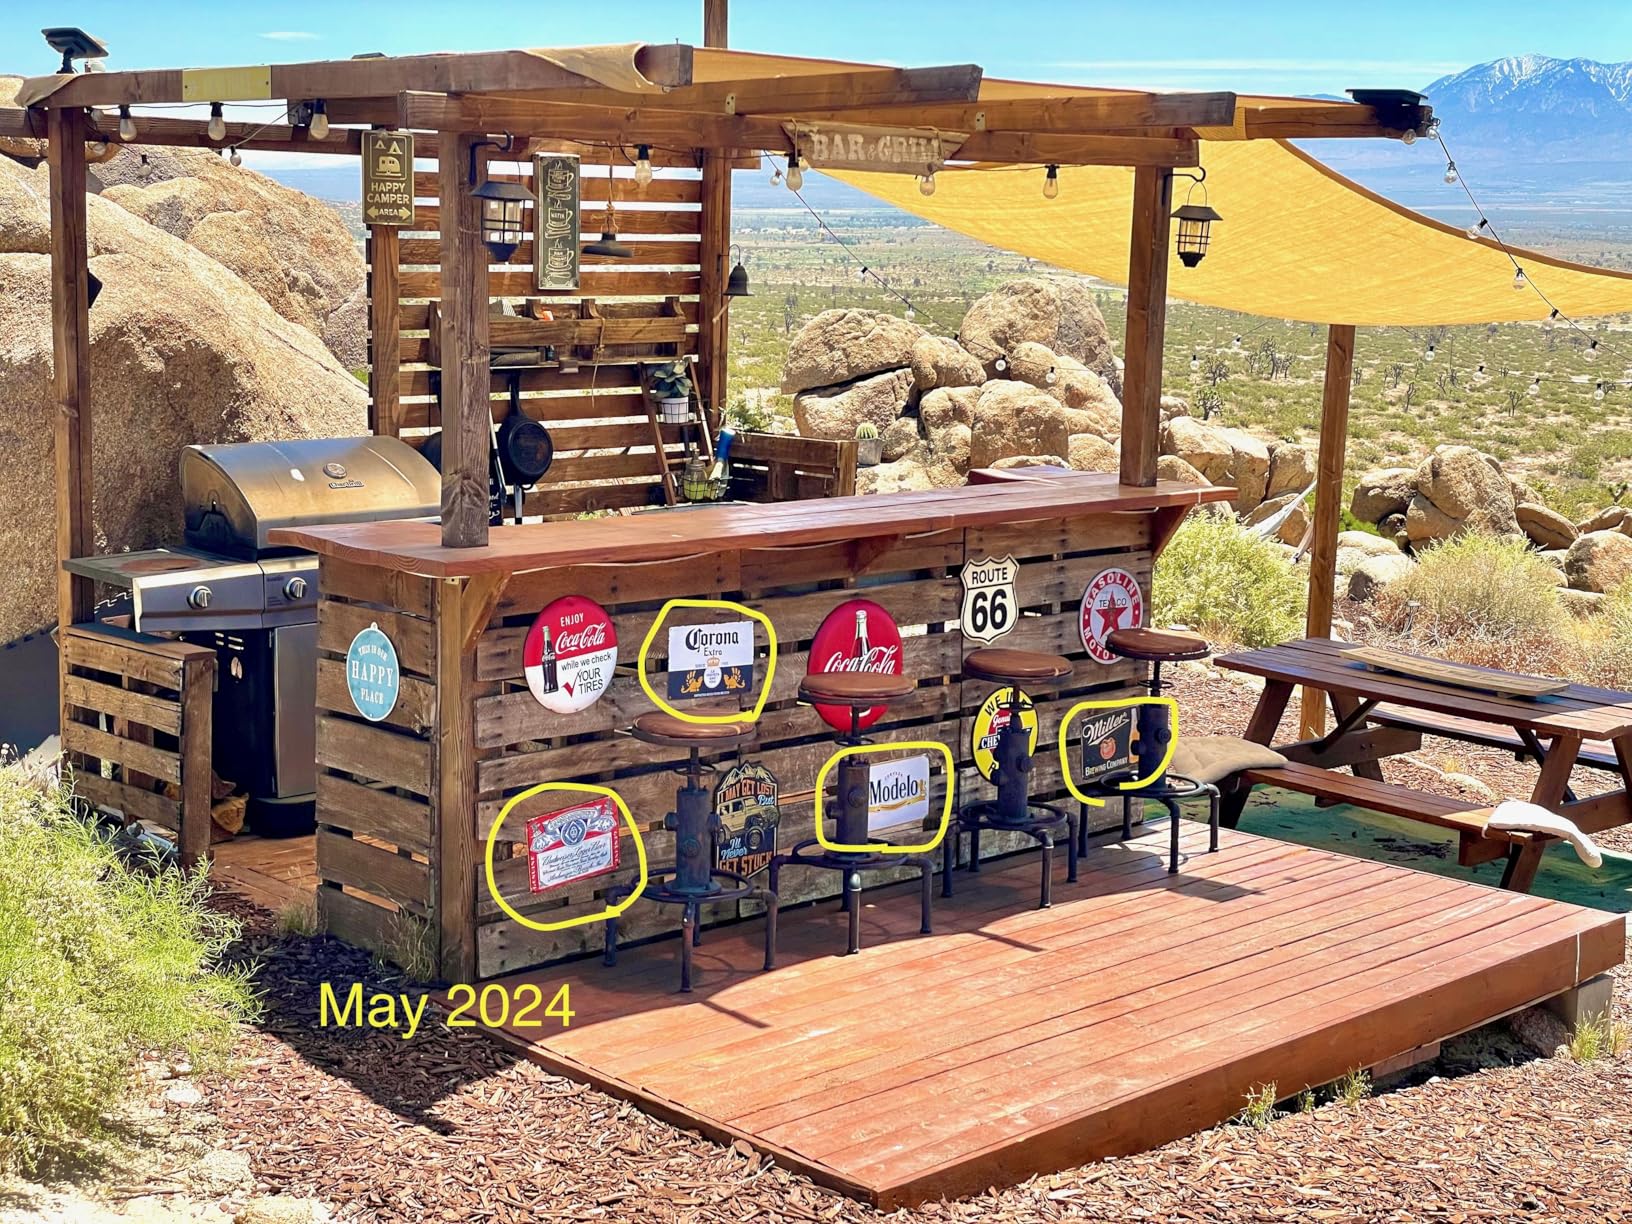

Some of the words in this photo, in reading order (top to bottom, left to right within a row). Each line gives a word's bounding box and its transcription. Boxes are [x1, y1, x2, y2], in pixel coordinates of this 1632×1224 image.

[812, 133, 865, 160] BAR
[867, 143, 876, 161] &
[371, 182, 405, 193] HAPPY
[366, 193, 410, 204] CAMPER
[378, 208, 398, 216] AREA
[971, 567, 1008, 584] ROUTE
[1086, 573, 1140, 609] GASOLINE
[560, 612, 584, 627] ENJOY
[971, 589, 1008, 633] 66
[685, 628, 739, 653] Corona
[561, 662, 580, 671] while
[580, 659, 591, 667] we
[591, 651, 612, 664] check
[703, 647, 723, 657] Extra
[351, 660, 393, 687] HAPPY
[578, 667, 601, 683] YOUR
[360, 687, 384, 705] PLACE
[578, 679, 604, 695] TIRES
[984, 694, 1001, 717] WE
[1082, 711, 1128, 746] Miller
[725, 782, 741, 801] MAY
[741, 780, 756, 797] GET
[756, 782, 774, 795] LOST
[870, 774, 918, 805] Modelo
[757, 794, 774, 806] But
[720, 847, 748, 861] Never
[720, 858, 737, 873] GET
[741, 851, 774, 876] STUCK
